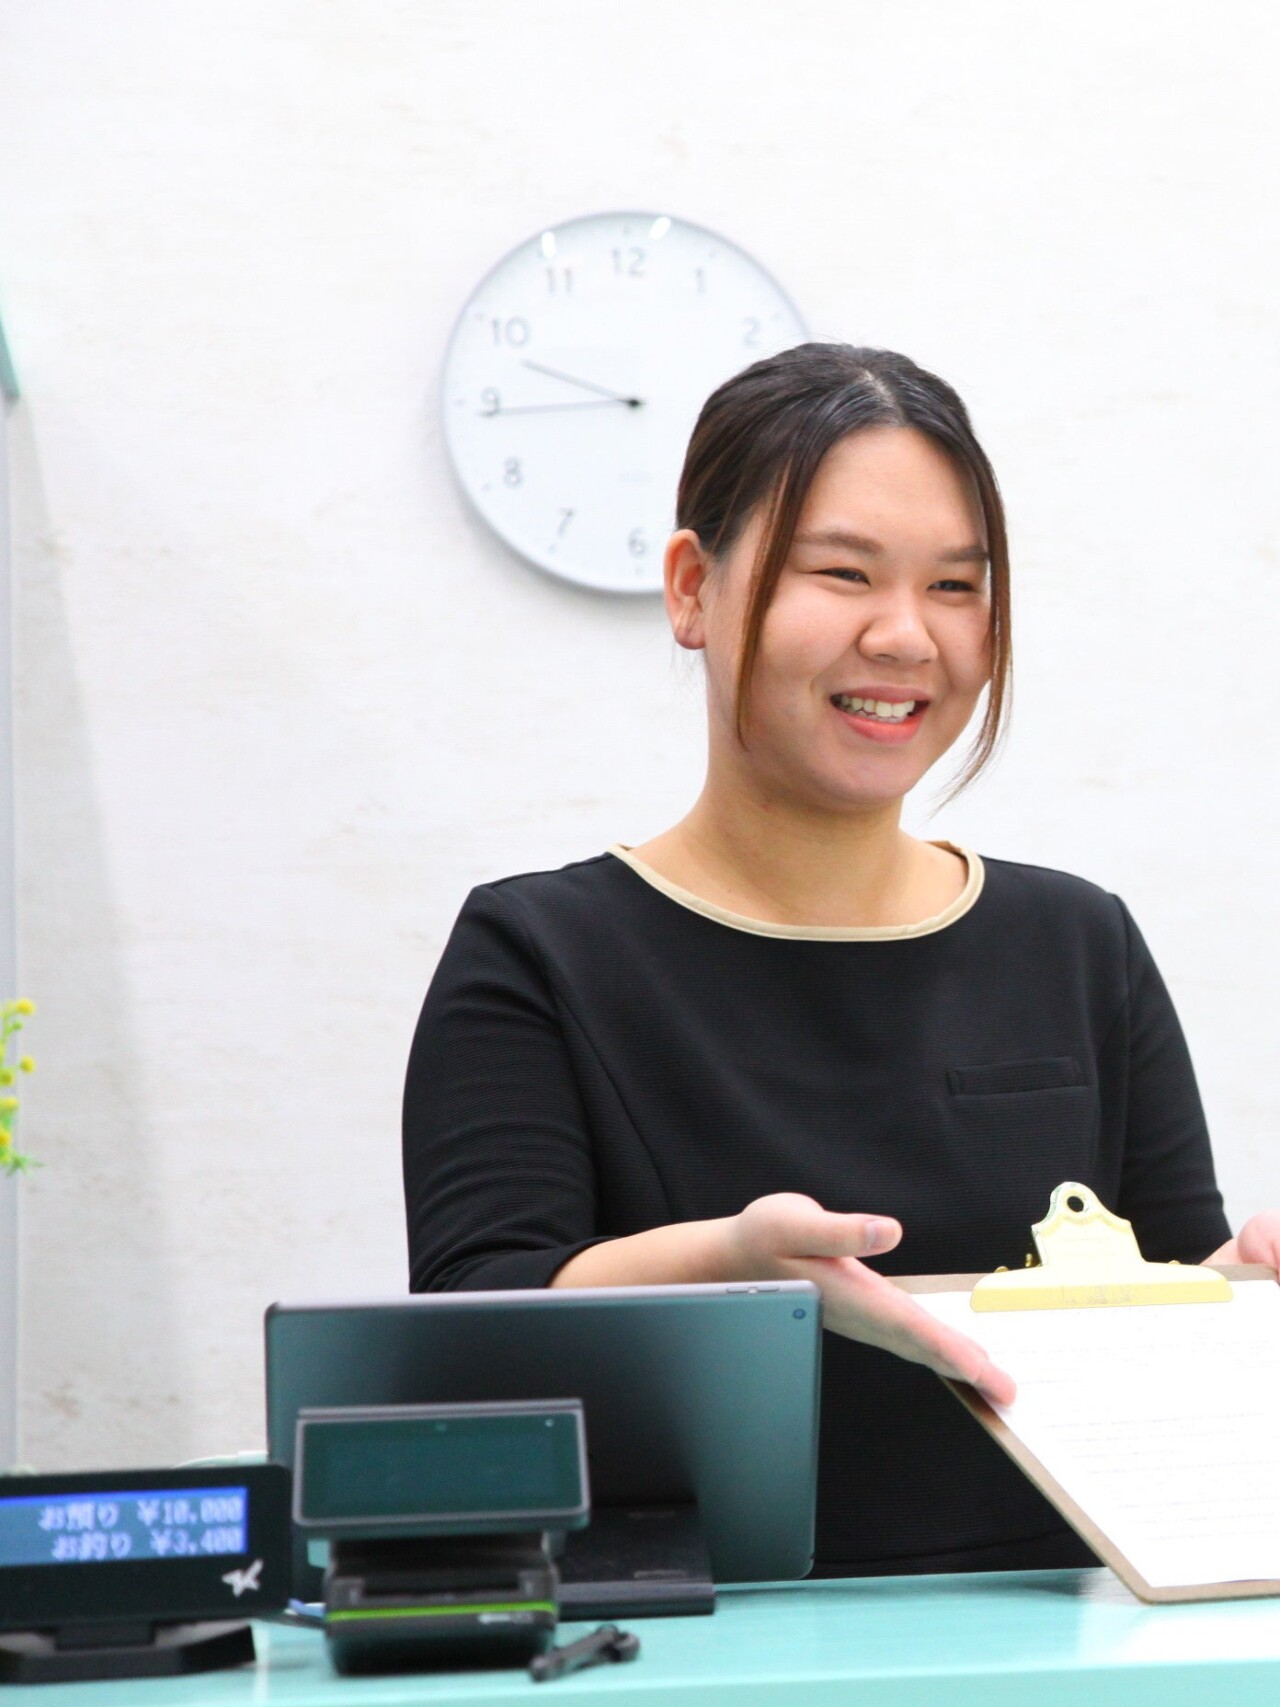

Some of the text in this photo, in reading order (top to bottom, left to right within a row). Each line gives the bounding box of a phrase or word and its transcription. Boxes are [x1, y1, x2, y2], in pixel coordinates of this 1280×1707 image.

[611, 246, 647, 277] 12
[546, 267, 574, 296] 11
[694, 267, 706, 294] 1
[490, 316, 532, 347] 10
[741, 316, 761, 347] 2
[480, 386, 502, 417] 9
[503, 456, 525, 488] 8
[556, 507, 576, 537] 7
[627, 526, 647, 557] 6
